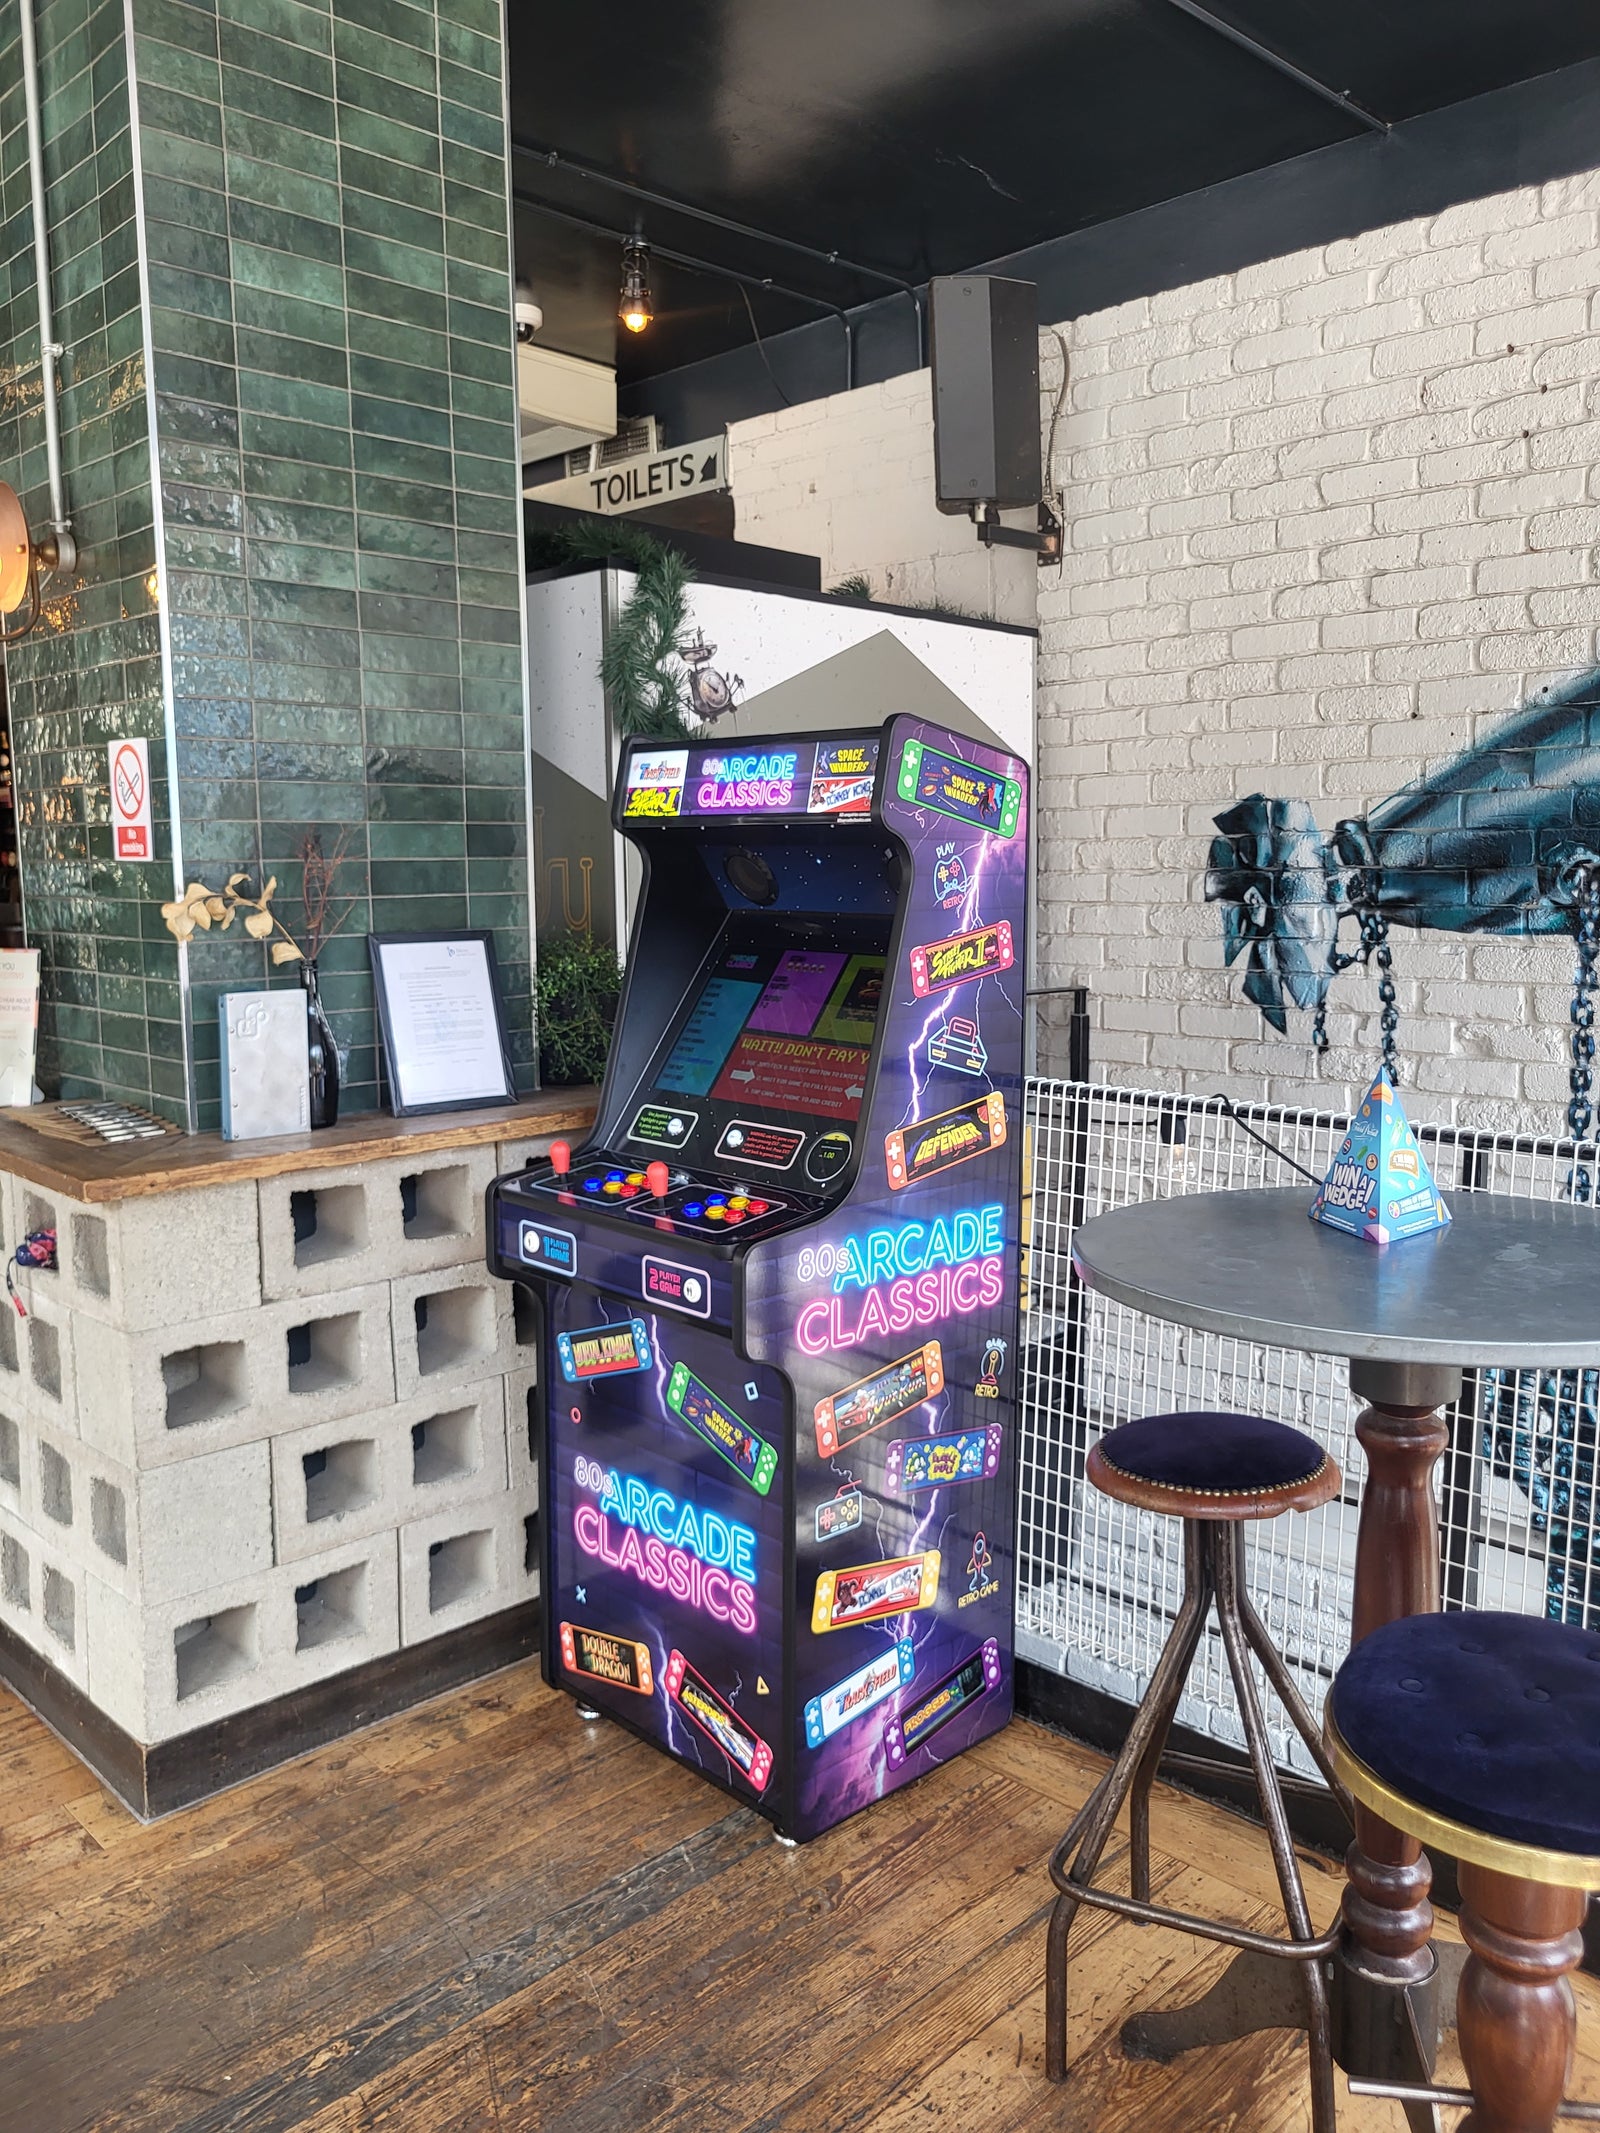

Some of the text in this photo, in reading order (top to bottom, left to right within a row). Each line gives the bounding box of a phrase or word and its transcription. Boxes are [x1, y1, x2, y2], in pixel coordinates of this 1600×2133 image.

[590, 453, 694, 509] TOILETS
[714, 754, 797, 782] ARCADE
[829, 761, 870, 774] INVADERS
[837, 748, 865, 761] SPACE
[697, 780, 793, 808] CLASSICS
[944, 784, 980, 806] INVADERS
[951, 774, 977, 794] SPACE
[936, 842, 956, 858] PLAY
[942, 894, 965, 910] RETRO
[742, 1038, 783, 1054] WAIT!!
[784, 1042, 826, 1059] DON'T
[827, 1048, 858, 1063] PAY
[914, 1122, 983, 1166] DEFENDER
[1332, 1158, 1368, 1190] WIN A
[1323, 1179, 1376, 1213] WEDGE!
[797, 1205, 1003, 1293] 80s ARCADE
[649, 1267, 681, 1290] 2 PLAYER
[659, 1280, 681, 1297] GAME
[796, 1257, 1002, 1355] CLASSICS
[974, 1383, 999, 1399] RETRO
[704, 1414, 736, 1448] INVADERS
[711, 1410, 734, 1433] SPACE
[574, 1455, 756, 1583] 80s ARCADE
[574, 1505, 756, 1633] CLASSICS
[858, 1568, 912, 1609] DONKEY KONG
[958, 1580, 1000, 1609] RETRO GAME
[581, 1633, 620, 1662] DOUBLE
[591, 1653, 632, 1685] DRAGON
[835, 1683, 870, 1716] TRACK
[873, 1662, 897, 1691] FIELD
[681, 1688, 727, 1727] ASTEROIDS
[903, 1688, 951, 1736] FROGGER
